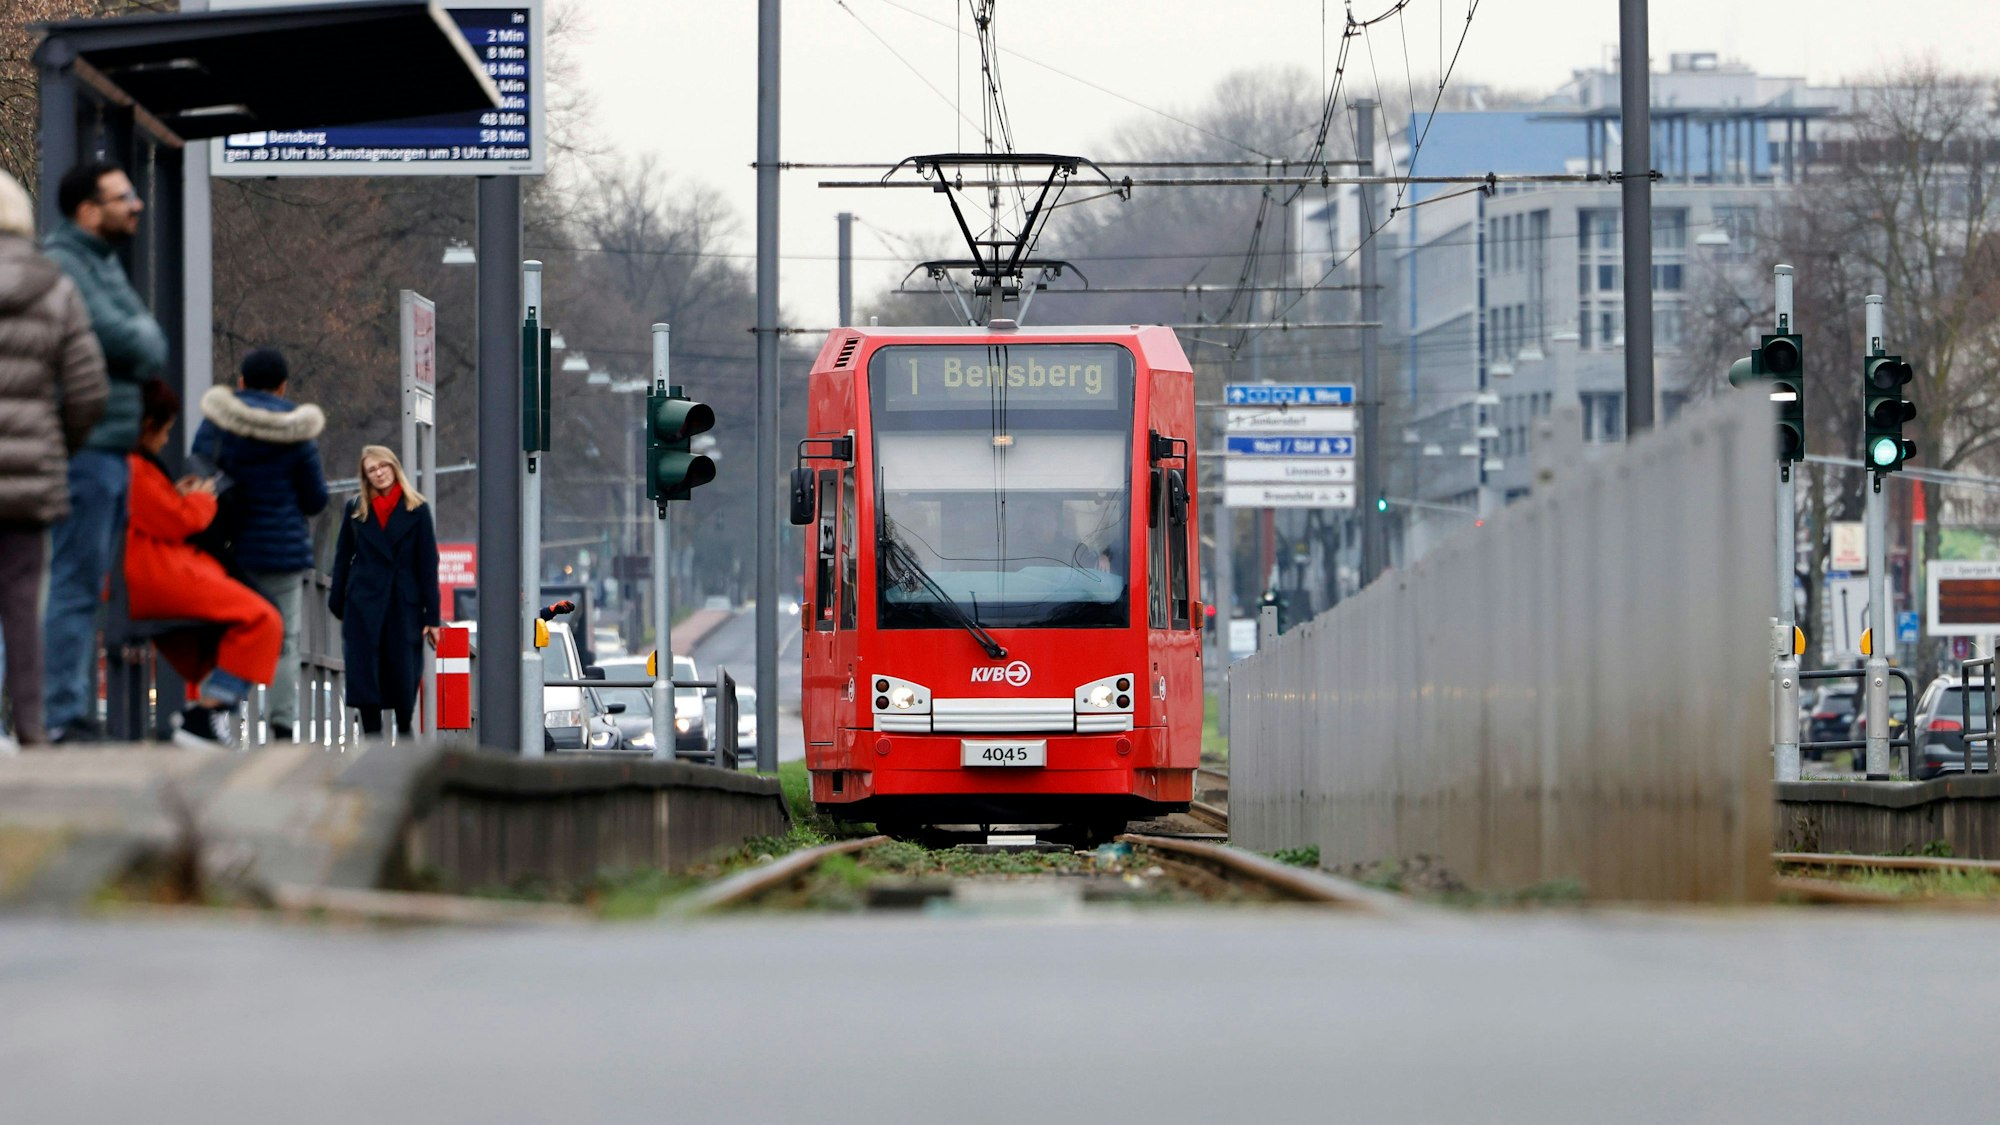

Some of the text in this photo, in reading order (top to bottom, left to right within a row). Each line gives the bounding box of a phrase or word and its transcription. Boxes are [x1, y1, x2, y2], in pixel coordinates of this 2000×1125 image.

[511, 12, 525, 24] in
[487, 29, 525, 43] 2 Min
[487, 46, 525, 59] 8 Min
[499, 63, 525, 76] Min
[499, 79, 526, 93] Min
[480, 112, 526, 126] 48 Min
[268, 130, 327, 146] Bensberg
[480, 129, 498, 143] 58
[499, 129, 526, 143] Min
[252, 147, 269, 160] ab
[270, 147, 280, 160] 3
[282, 147, 306, 160] Uhr
[308, 147, 327, 160] bis
[327, 146, 426, 162] Samstagmorgen
[428, 149, 449, 159] um
[452, 146, 461, 159] 3
[463, 146, 486, 159] Uhr
[487, 145, 530, 159] fahren
[908, 357, 1102, 395] 1 Bensberg
[970, 666, 1006, 682] KVB
[982, 747, 1028, 761] 4045
